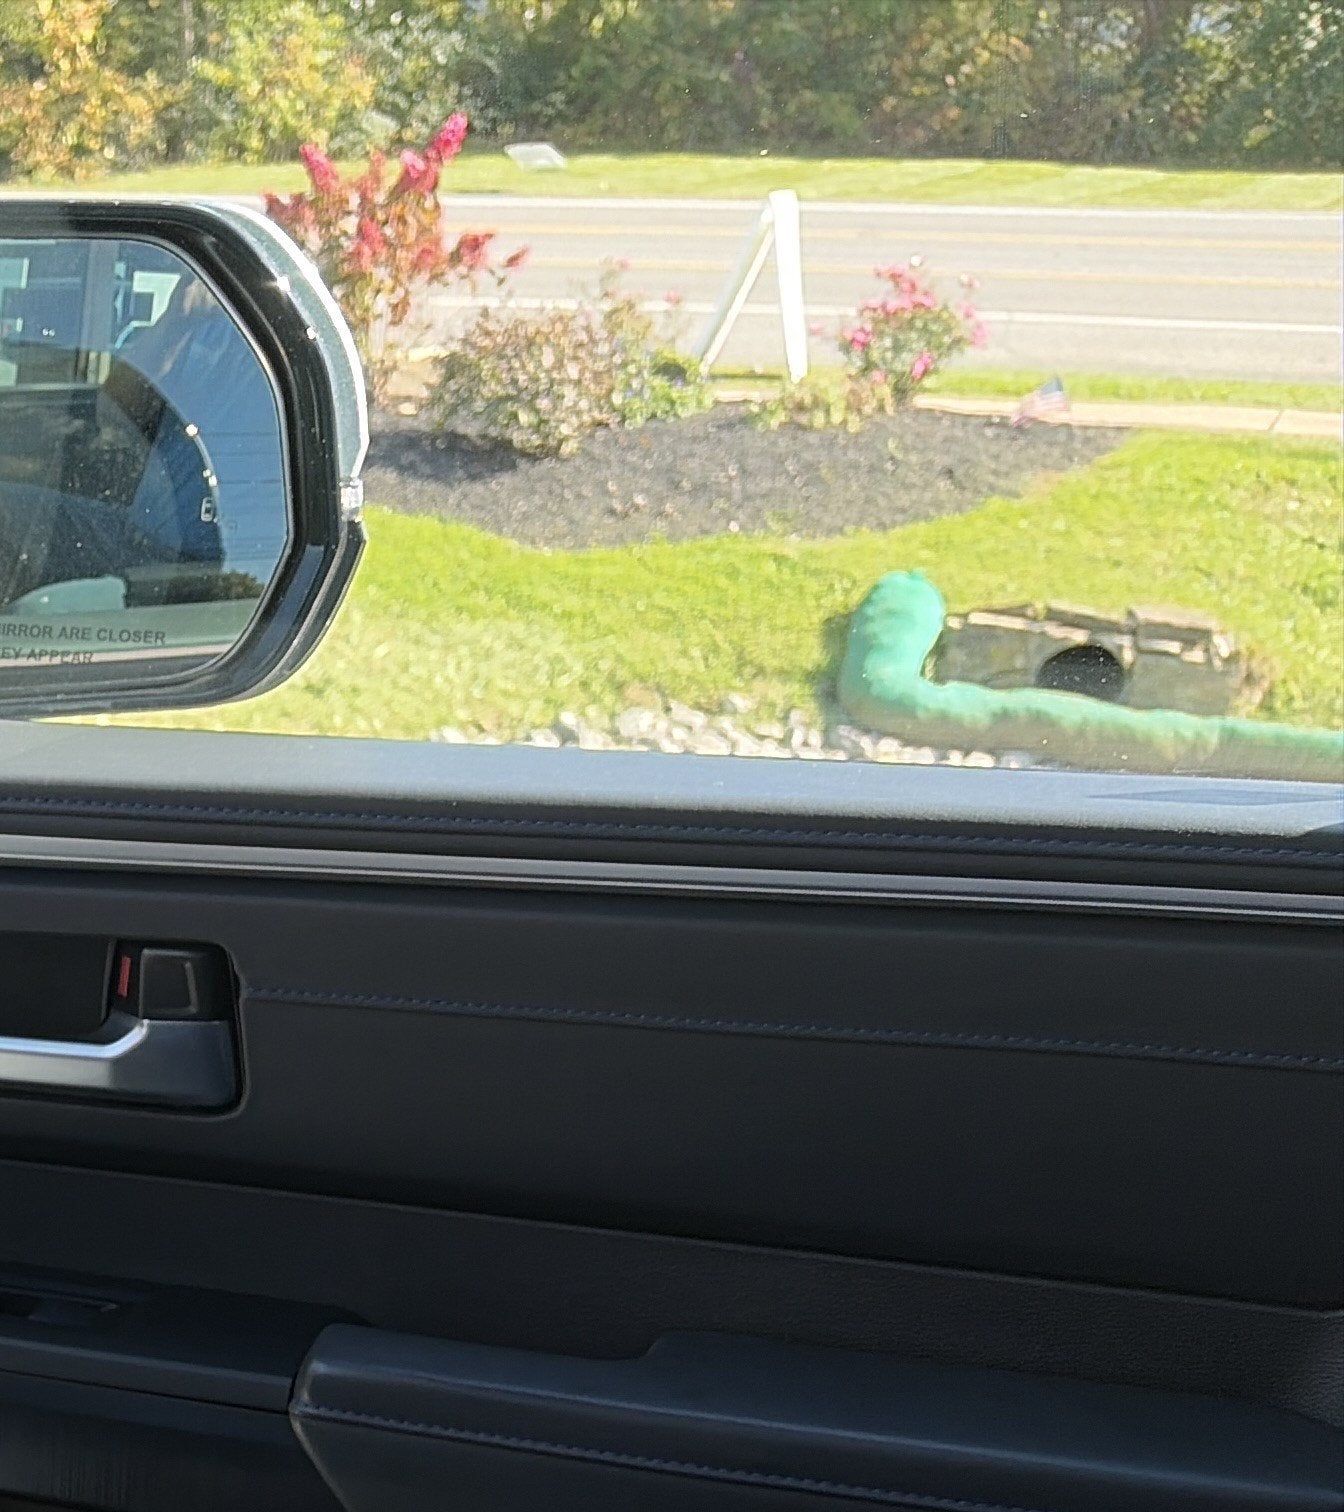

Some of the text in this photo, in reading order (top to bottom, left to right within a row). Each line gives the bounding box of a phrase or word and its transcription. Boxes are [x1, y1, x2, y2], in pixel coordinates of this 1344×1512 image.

[56, 623, 93, 641] ARE
[96, 625, 167, 645] CLOSER
[25, 646, 94, 665] APPEAR
